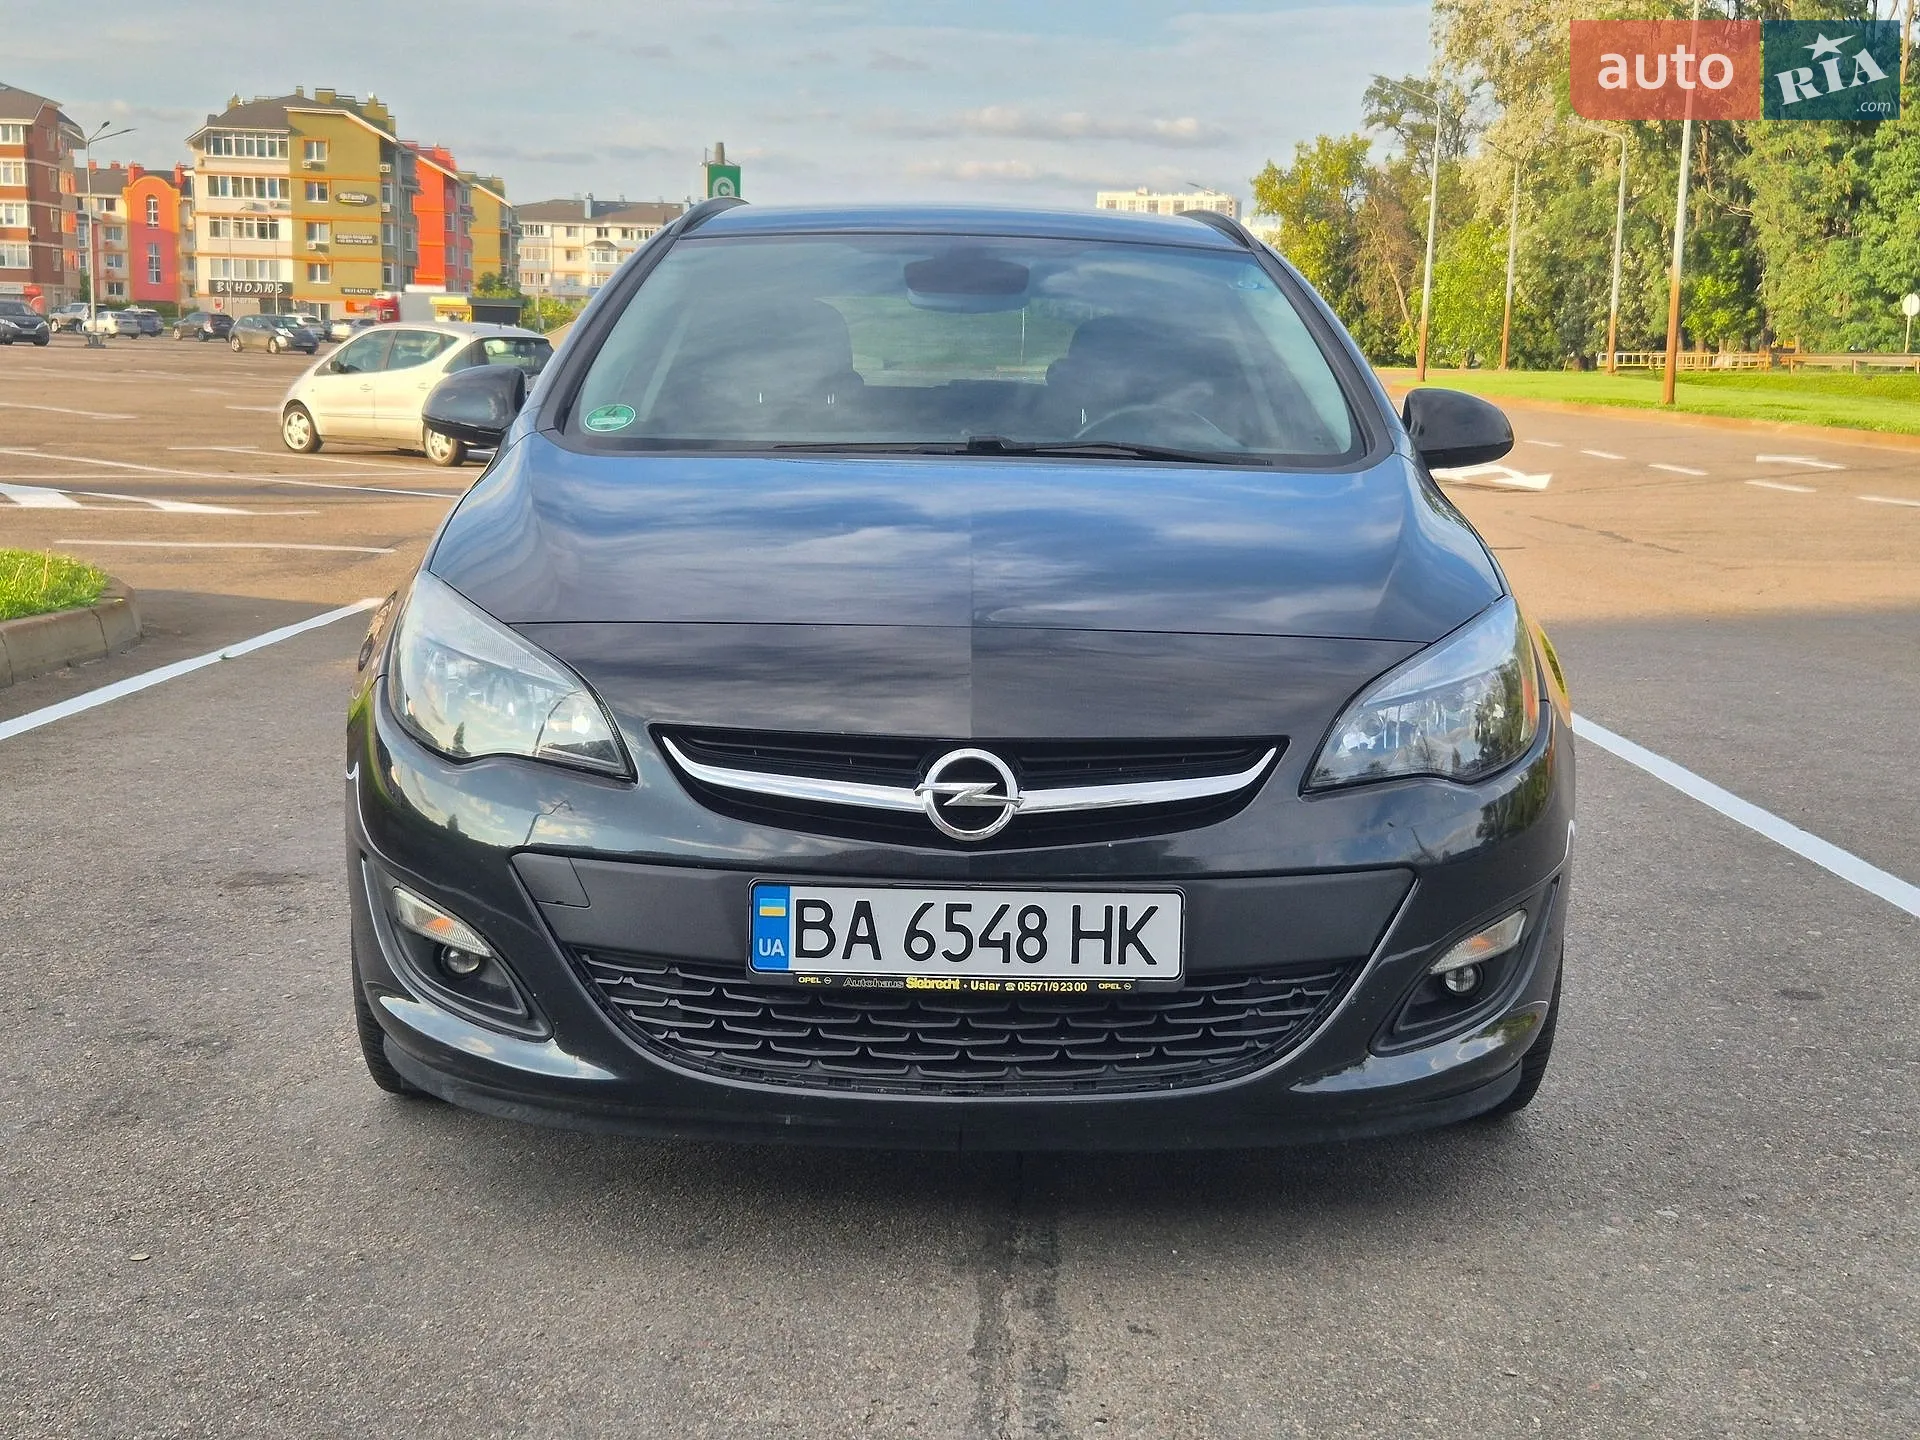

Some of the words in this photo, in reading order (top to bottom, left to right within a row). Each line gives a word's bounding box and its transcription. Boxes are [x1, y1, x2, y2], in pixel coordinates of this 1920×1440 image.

[795, 898, 882, 960] BA
[903, 902, 1049, 964] 6548
[1070, 904, 1159, 966] HK
[758, 938, 786, 957] UA
[798, 976, 822, 984] OPEL
[842, 977, 904, 989] Autohaus
[905, 976, 961, 990] Siebrecht
[970, 980, 1001, 991] Uslar
